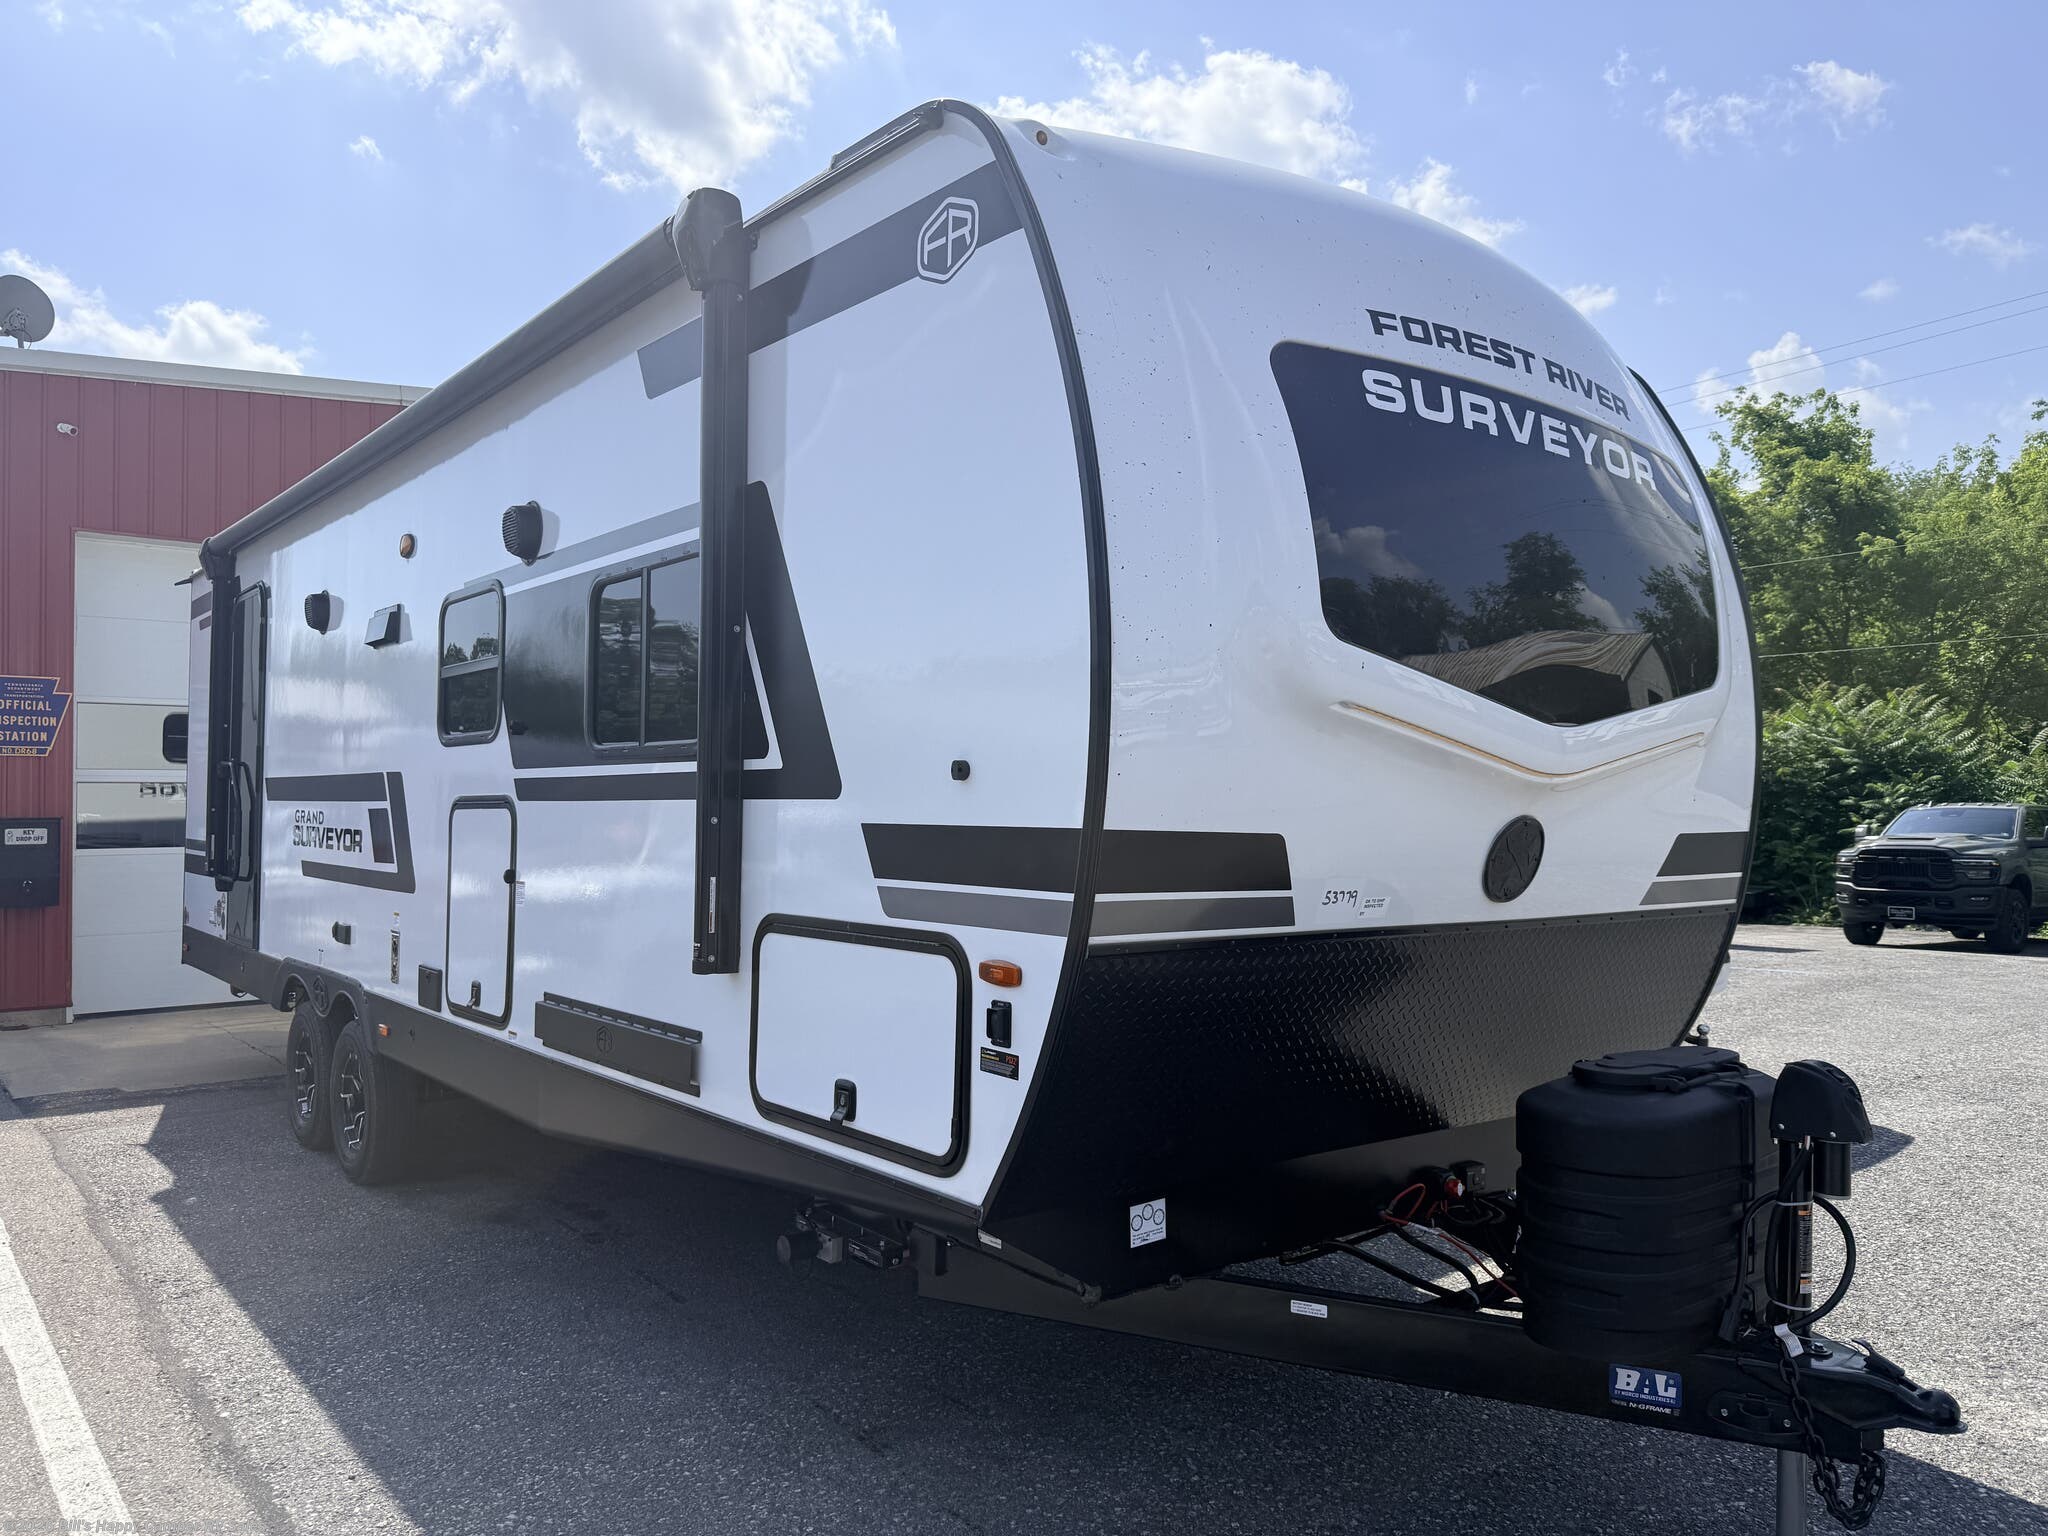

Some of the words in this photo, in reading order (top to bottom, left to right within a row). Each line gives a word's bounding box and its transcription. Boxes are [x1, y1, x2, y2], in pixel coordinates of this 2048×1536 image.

[1366, 308, 1536, 376] FOREST
[1542, 355, 1632, 422] RIVER
[1361, 368, 1658, 492] SURVEYOR
[292, 825, 363, 853] SURVEYOR
[294, 809, 325, 825] GRAND
